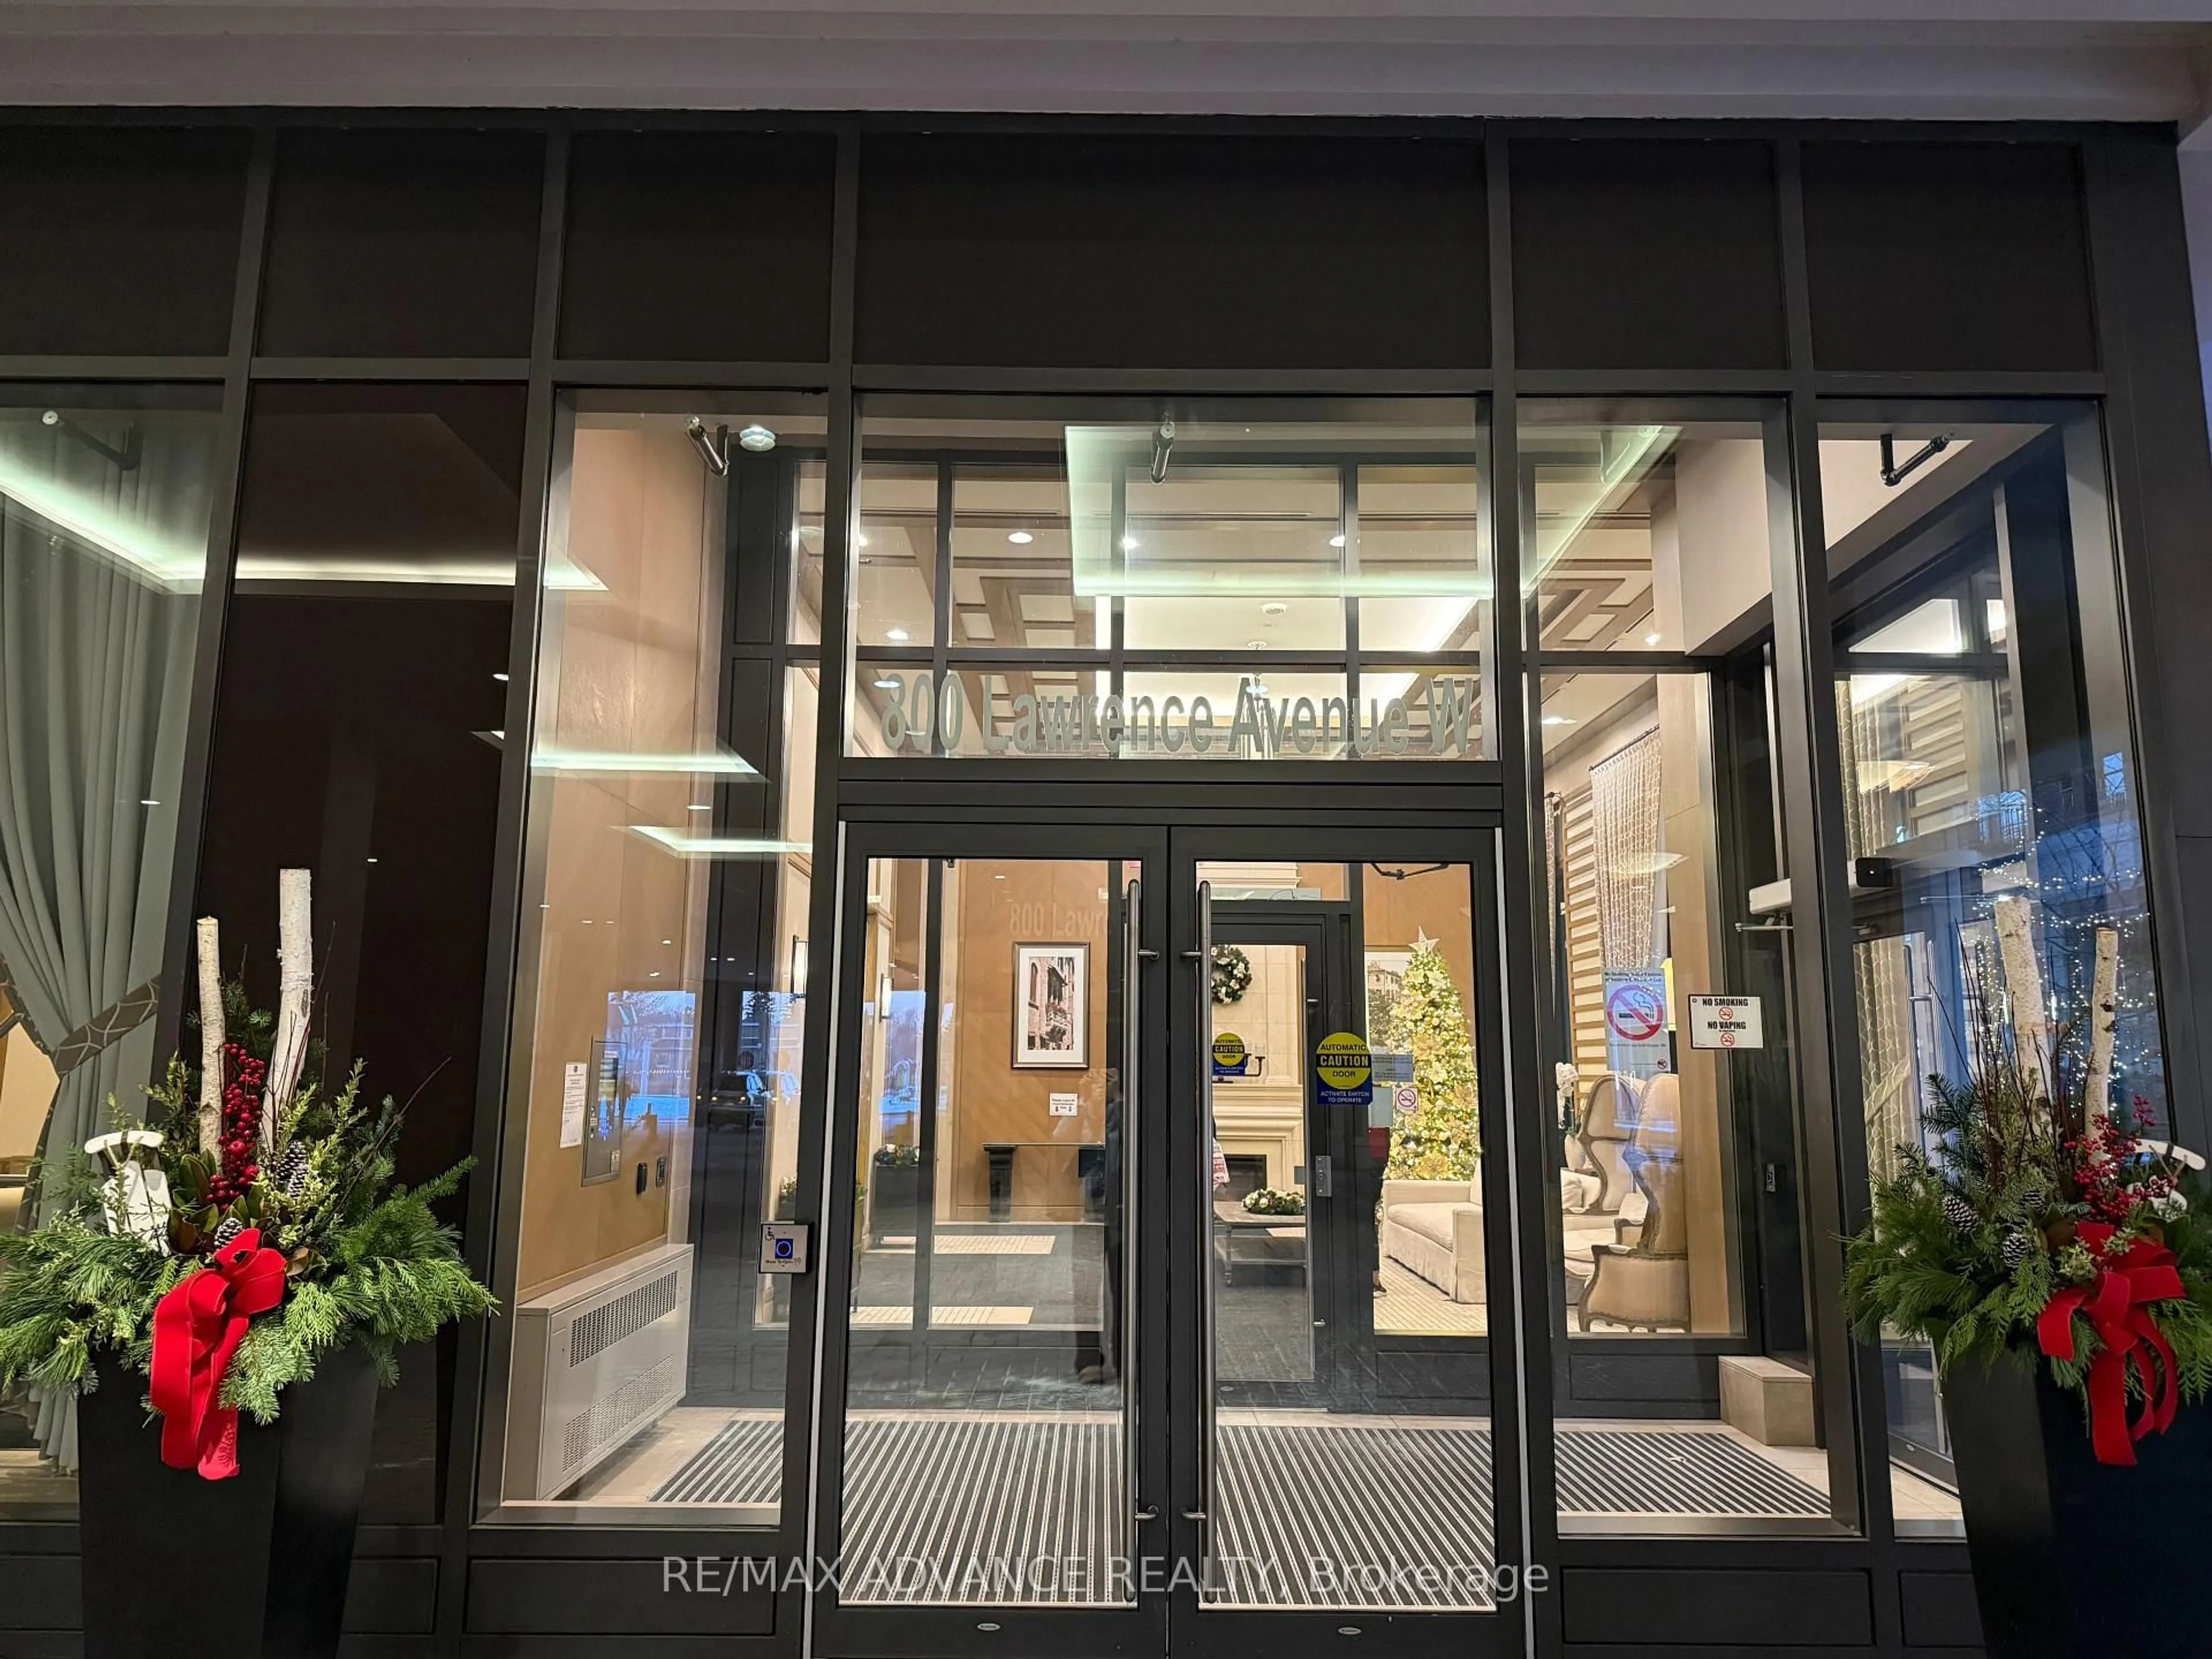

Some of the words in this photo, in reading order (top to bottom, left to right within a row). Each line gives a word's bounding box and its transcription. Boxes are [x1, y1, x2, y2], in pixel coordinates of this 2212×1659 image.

[882, 673, 963, 749] 800
[984, 675, 1213, 752] Lawrence
[1228, 677, 1409, 755] Avenue
[1426, 677, 1473, 753] W
[1010, 902, 1044, 936] 800
[1703, 998, 1713, 1006] NO
[1714, 998, 1748, 1006] SMOKING
[1719, 1021, 1746, 1029] VAPING
[1320, 1055, 1369, 1067] CAUTION
